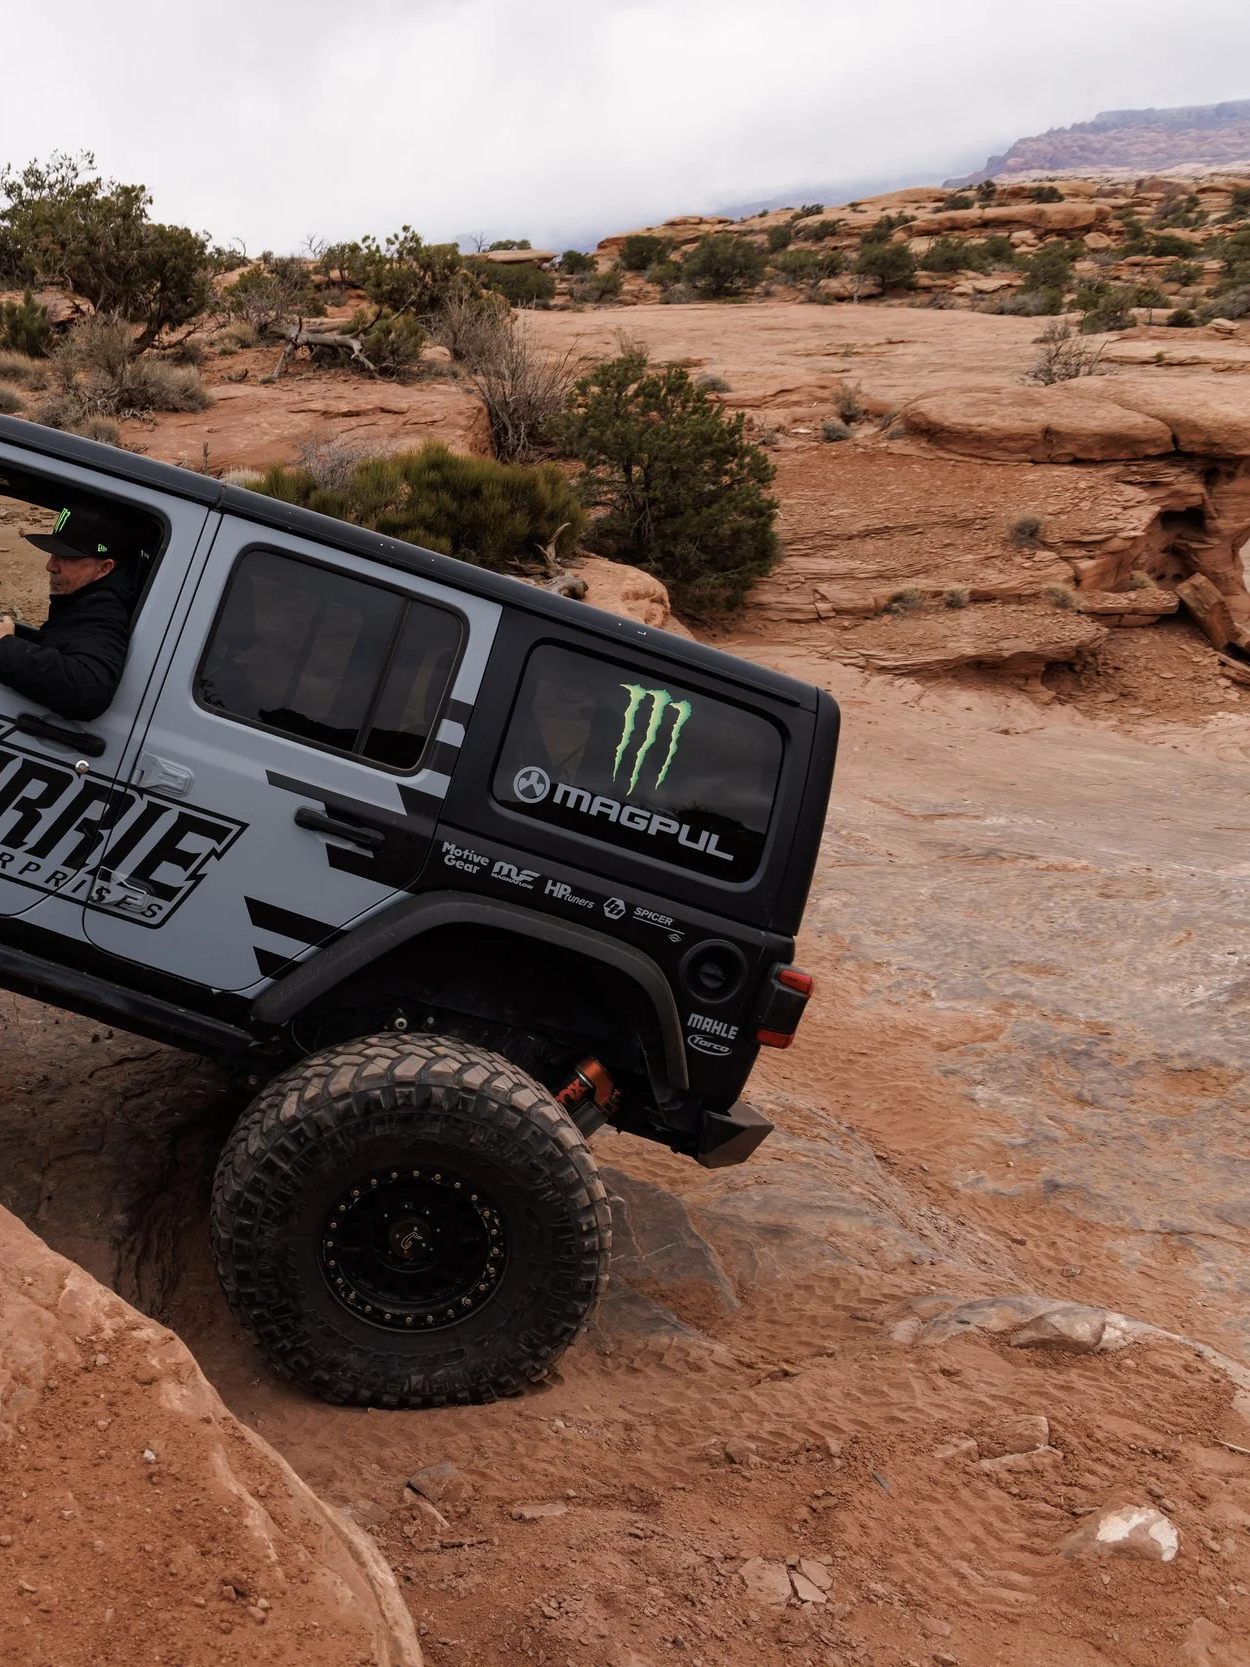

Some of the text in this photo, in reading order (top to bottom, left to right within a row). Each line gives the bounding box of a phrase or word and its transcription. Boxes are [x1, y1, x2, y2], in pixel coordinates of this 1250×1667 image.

[553, 782, 734, 862] MAGPUL
[441, 841, 490, 866] Motive
[443, 854, 481, 875] Gear
[490, 872, 534, 890] MAGNAFLOW
[633, 907, 674, 926] SPICER
[687, 1012, 739, 1040] MAHLE
[693, 1035, 730, 1053] Torco
[554, 1078, 588, 1104] OX
